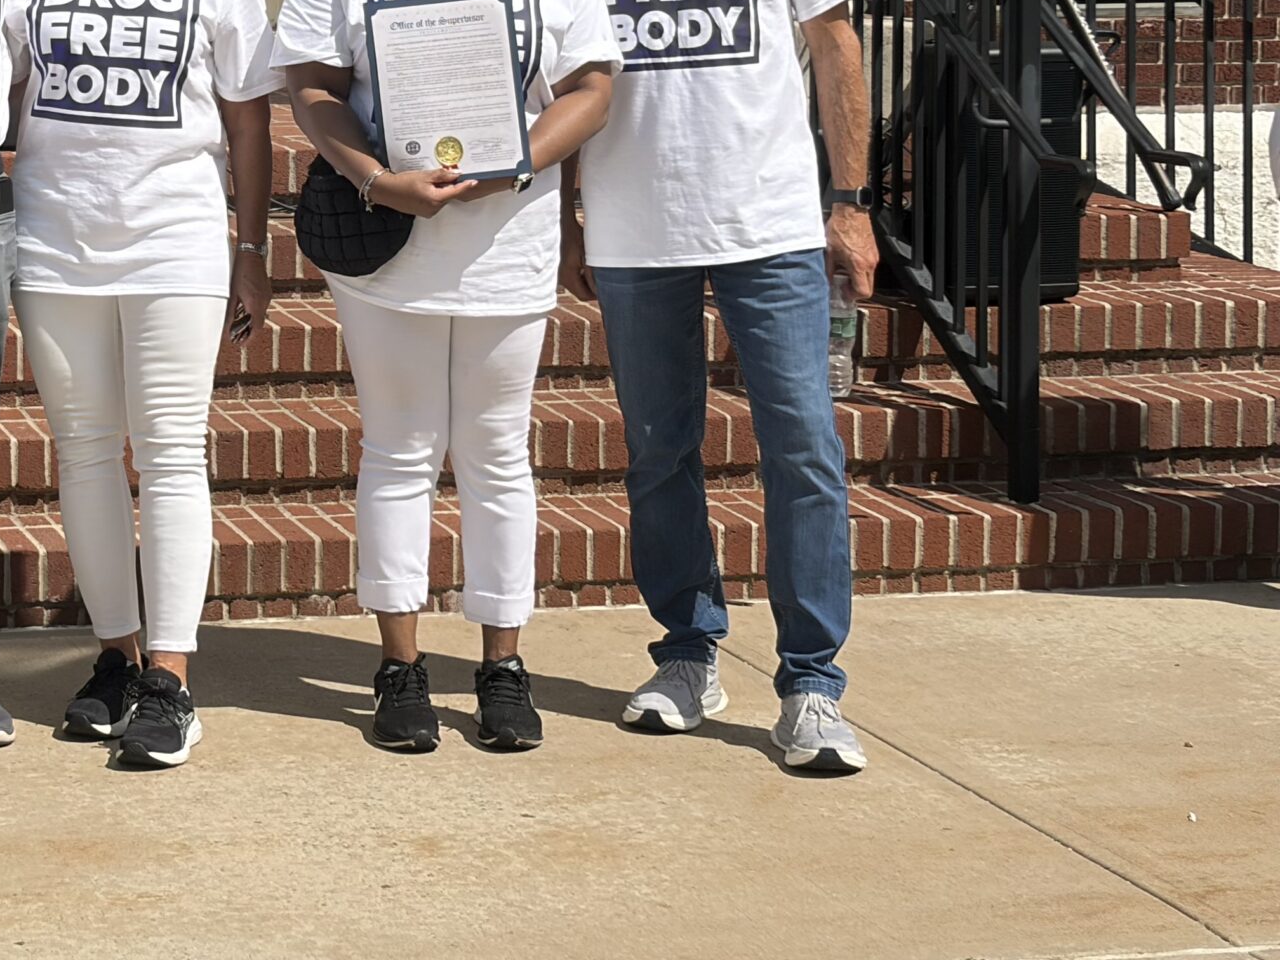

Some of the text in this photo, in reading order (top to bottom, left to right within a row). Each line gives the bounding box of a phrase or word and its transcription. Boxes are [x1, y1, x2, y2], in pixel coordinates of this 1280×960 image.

[40, 11, 180, 62] FREE
[389, 14, 485, 31] Office of the Supervisor
[614, 5, 744, 53] BODY
[42, 64, 169, 110] BODY
